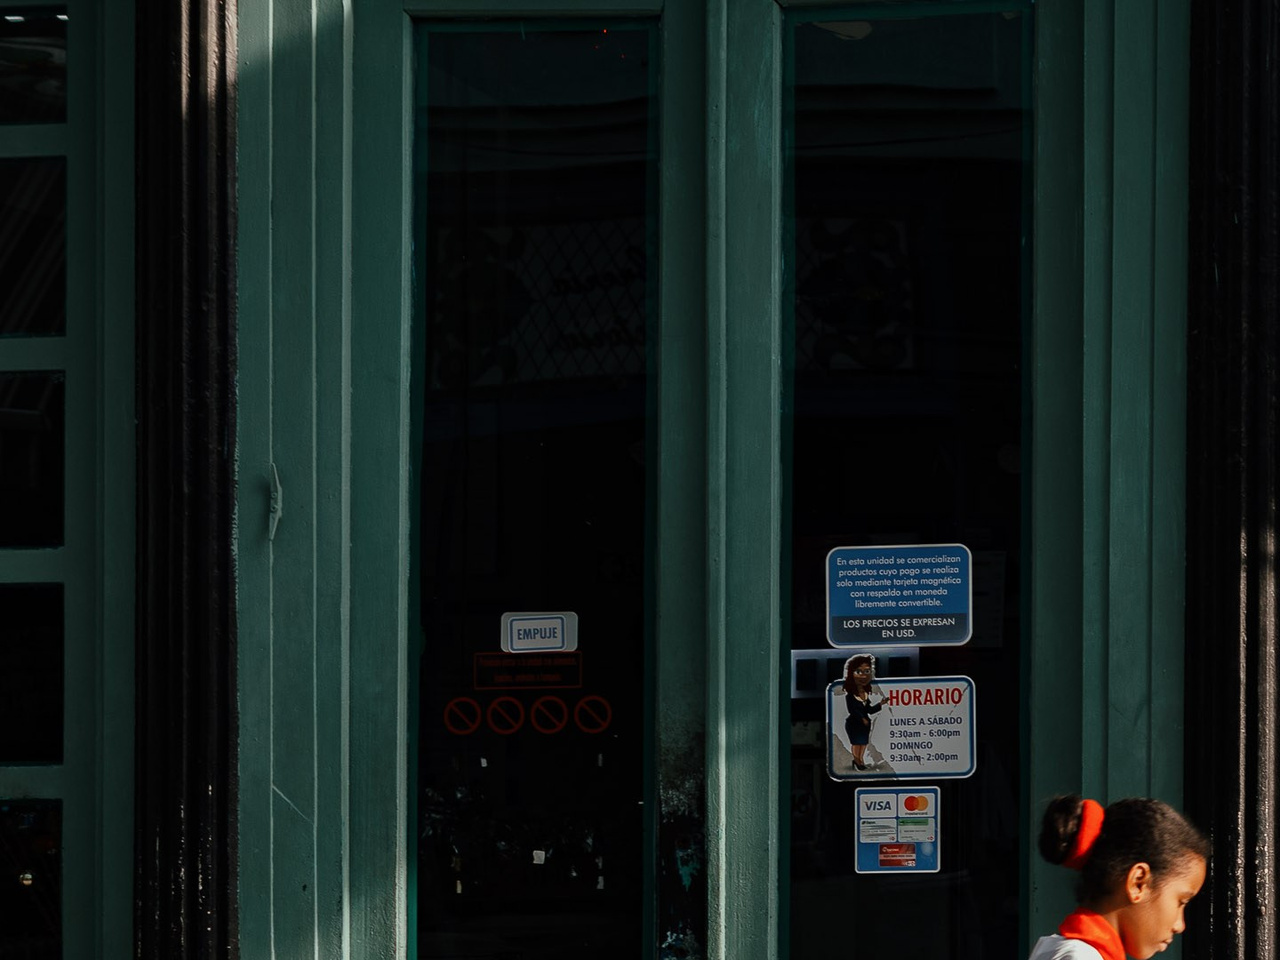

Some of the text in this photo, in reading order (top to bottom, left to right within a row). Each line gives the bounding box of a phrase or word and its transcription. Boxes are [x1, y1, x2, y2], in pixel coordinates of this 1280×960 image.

[837, 558, 847, 566] En
[849, 557, 865, 565] esta
[867, 556, 894, 565] unidad
[907, 555, 961, 563] comercializan
[838, 569, 877, 577] productos
[900, 568, 920, 576] pago
[933, 566, 959, 574] realiza
[855, 579, 891, 587] mediante
[894, 578, 918, 587] tarjeta
[921, 577, 961, 586] magnética
[867, 589, 900, 598] respaldo
[915, 588, 947, 596] moneda
[855, 599, 943, 608] libremente convertible.
[843, 620, 860, 628] LOS
[901, 619, 911, 627] SE
[913, 618, 955, 626] EXPRESAN
[517, 627, 558, 640] EMPUJE
[882, 629, 917, 638] EN USD.
[889, 688, 963, 706] HORARIO
[890, 718, 917, 726] LUNES
[928, 715, 962, 725] SÁBADO
[890, 729, 921, 738] 9:30am
[929, 729, 960, 738] 6:00pm
[890, 741, 933, 750] DOMINGO
[927, 753, 958, 762] 2:00pm
[864, 801, 891, 811] VISA
